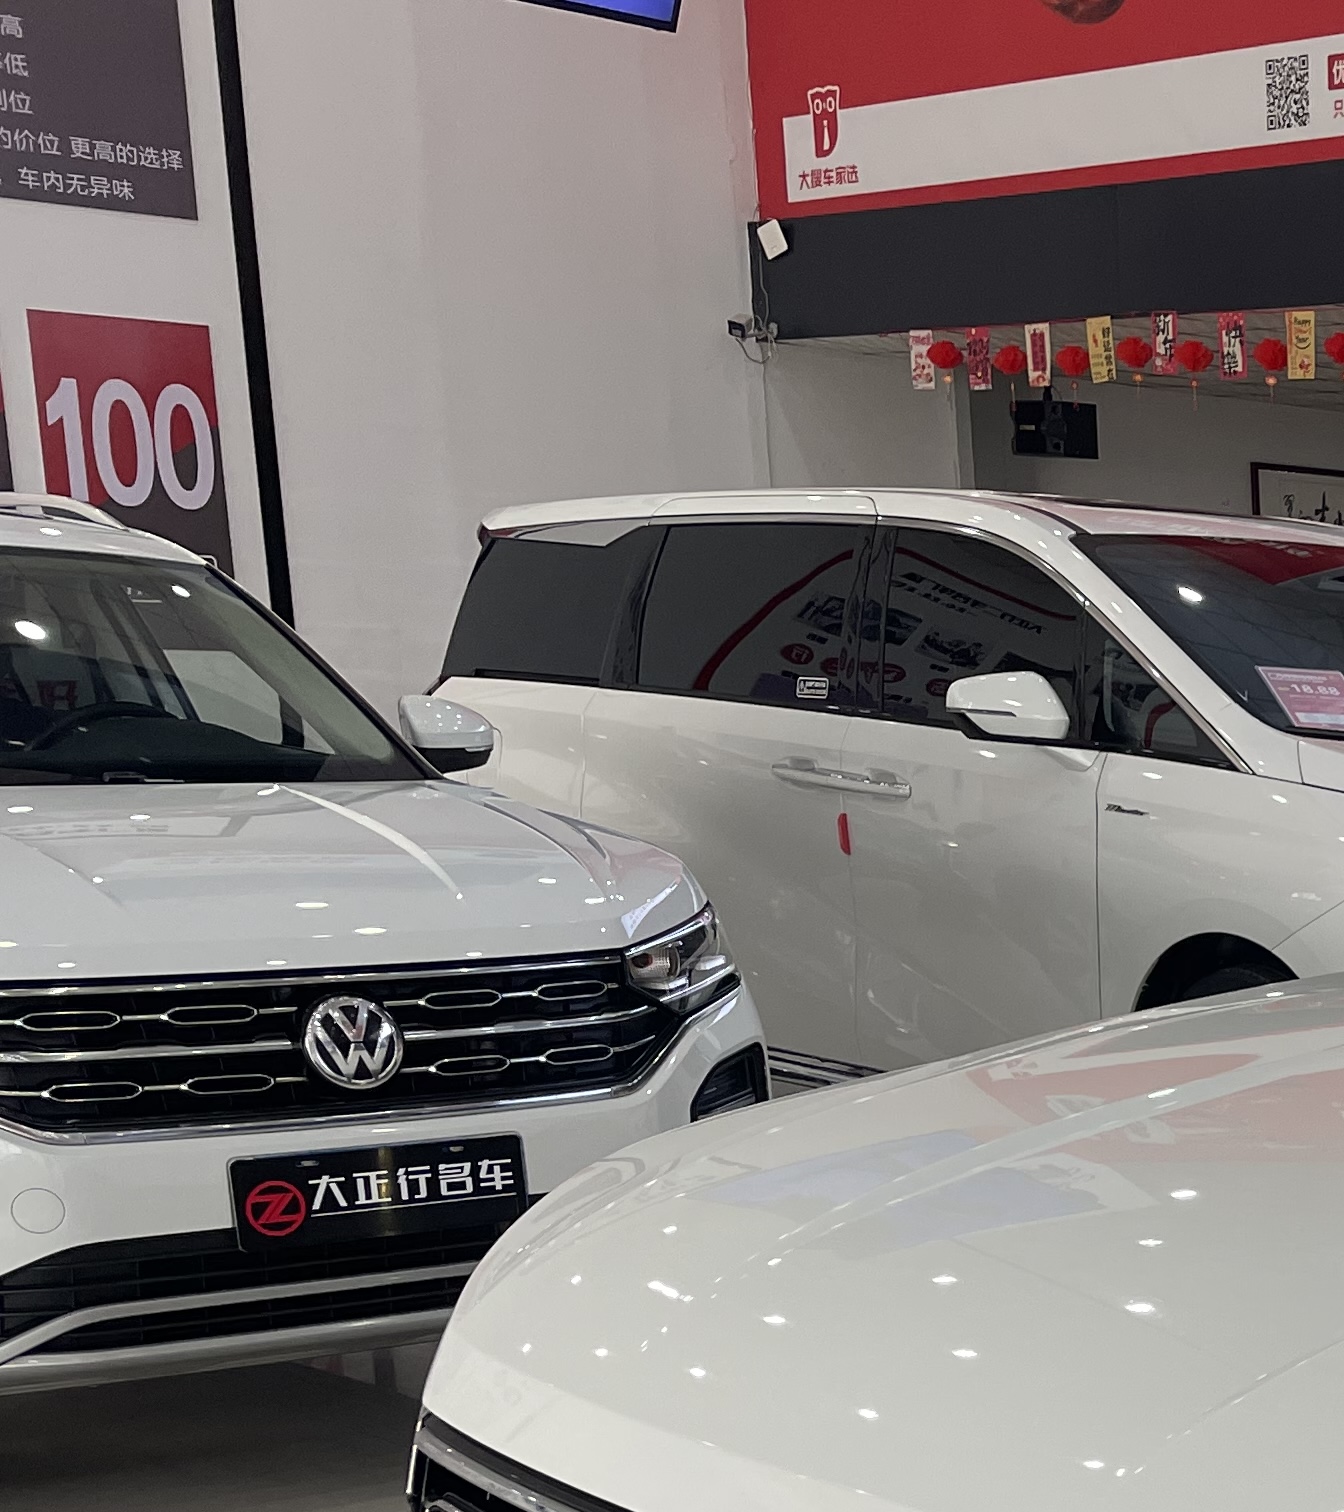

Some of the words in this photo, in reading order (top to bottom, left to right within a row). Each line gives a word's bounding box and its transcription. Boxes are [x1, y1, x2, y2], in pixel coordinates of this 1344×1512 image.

[0, 51, 29, 78] 低
[69, 136, 184, 172] 更高的选择
[18, 166, 135, 201] 车内无异味
[1155, 311, 1177, 363] 新年
[44, 377, 216, 511] 100
[309, 1156, 516, 1211] 大正行名车
